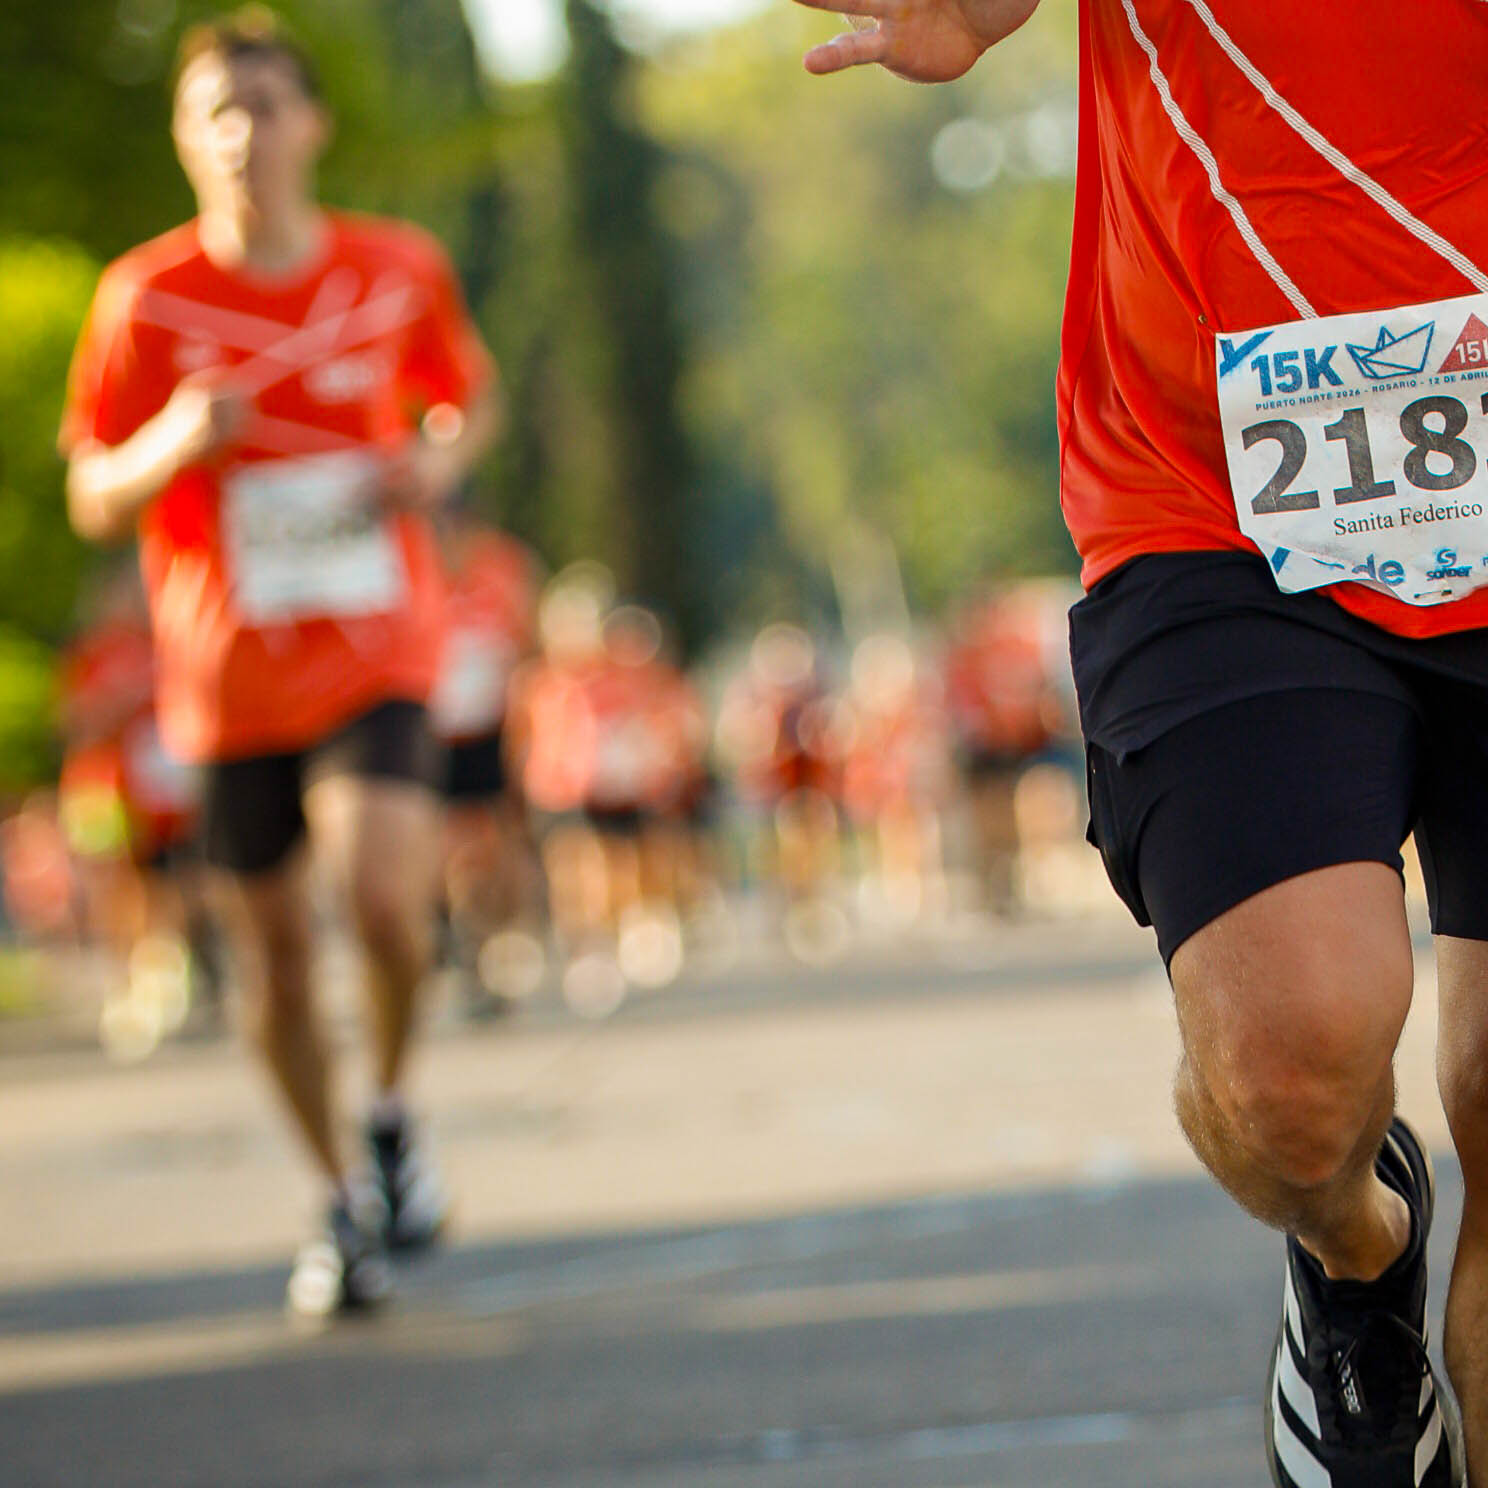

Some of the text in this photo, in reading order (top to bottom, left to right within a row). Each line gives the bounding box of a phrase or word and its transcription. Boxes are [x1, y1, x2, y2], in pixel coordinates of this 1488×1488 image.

[1250, 344, 1345, 397] 15K
[1256, 399, 1296, 411] PUERTO
[1299, 393, 1334, 405] NORTE
[1336, 388, 1361, 400] 2026
[1372, 379, 1417, 393] ROSARIO
[1428, 377, 1440, 386] 12
[1444, 375, 1457, 384] DE
[1333, 500, 1483, 536] Sanita Federico
